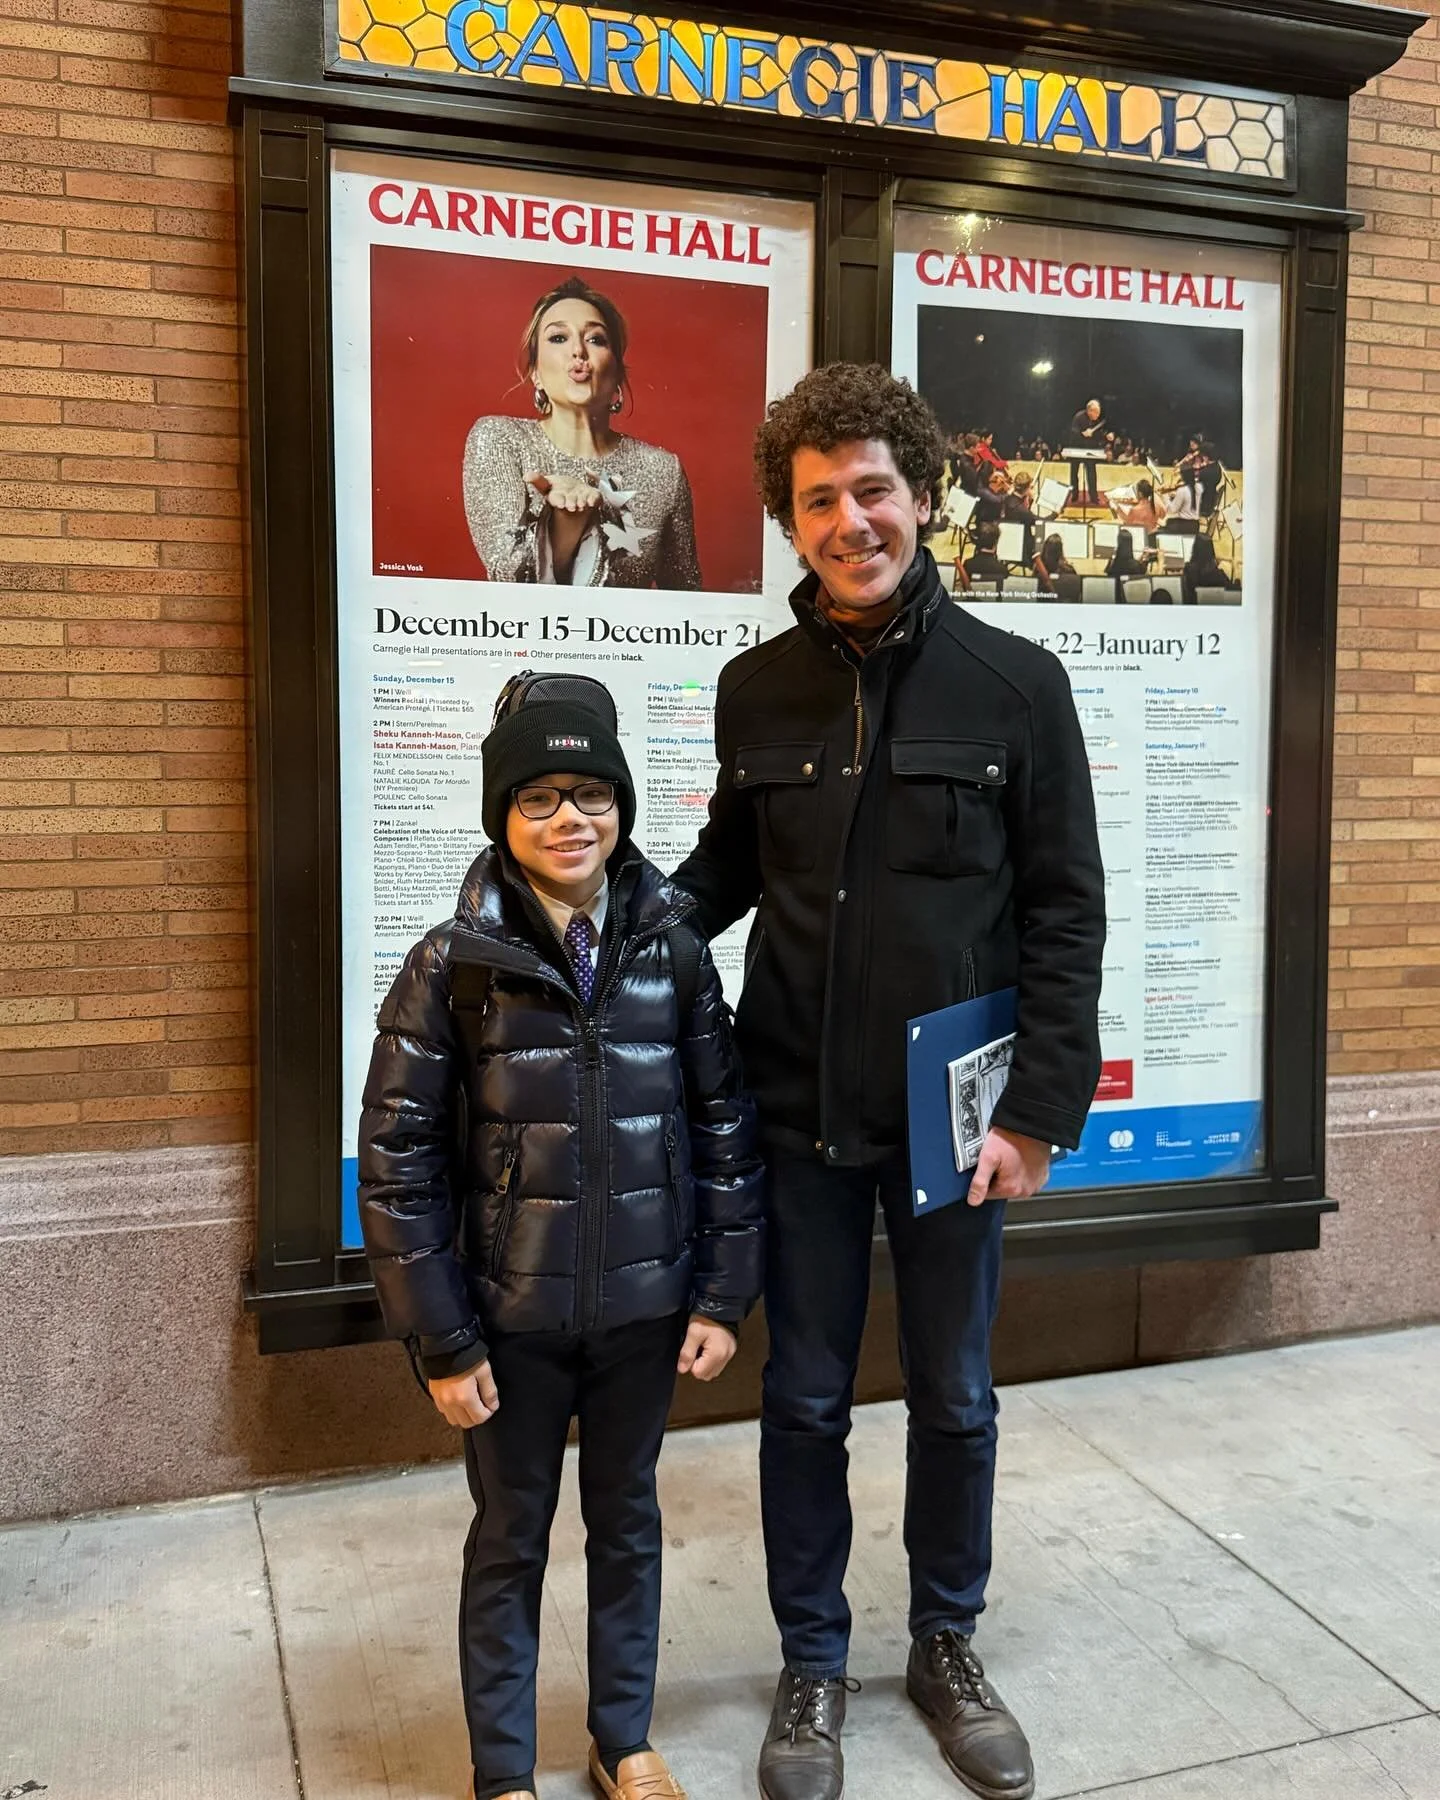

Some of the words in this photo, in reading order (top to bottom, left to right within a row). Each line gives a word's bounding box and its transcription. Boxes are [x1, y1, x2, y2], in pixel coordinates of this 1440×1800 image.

[445, 0, 936, 131] CARNEGIE
[988, 74, 1207, 158] HALL
[369, 184, 634, 251] CARNEGIE
[645, 214, 771, 266] HALL
[916, 250, 1132, 301] CARNEGIE
[1141, 269, 1244, 311] HALL
[380, 563, 405, 571] Jessica
[373, 608, 529, 640] December
[1195, 633, 1220, 655] 12
[372, 644, 411, 655] Carnegie
[413, 646, 430, 654] Hall
[432, 646, 488, 658] presentations
[514, 650, 529, 658] red.
[530, 650, 553, 659] Other
[555, 652, 596, 662] presenters
[612, 652, 620, 661] in
[622, 654, 645, 662] black.
[1068, 665, 1102, 674] presenters
[373, 675, 404, 684] Sunday,
[406, 676, 444, 684] December
[648, 683, 672, 691] Friday,
[401, 731, 463, 740] Kanneh-Mason,
[647, 737, 680, 745] Saturday,
[396, 742, 458, 751] Kanneh-Mason,
